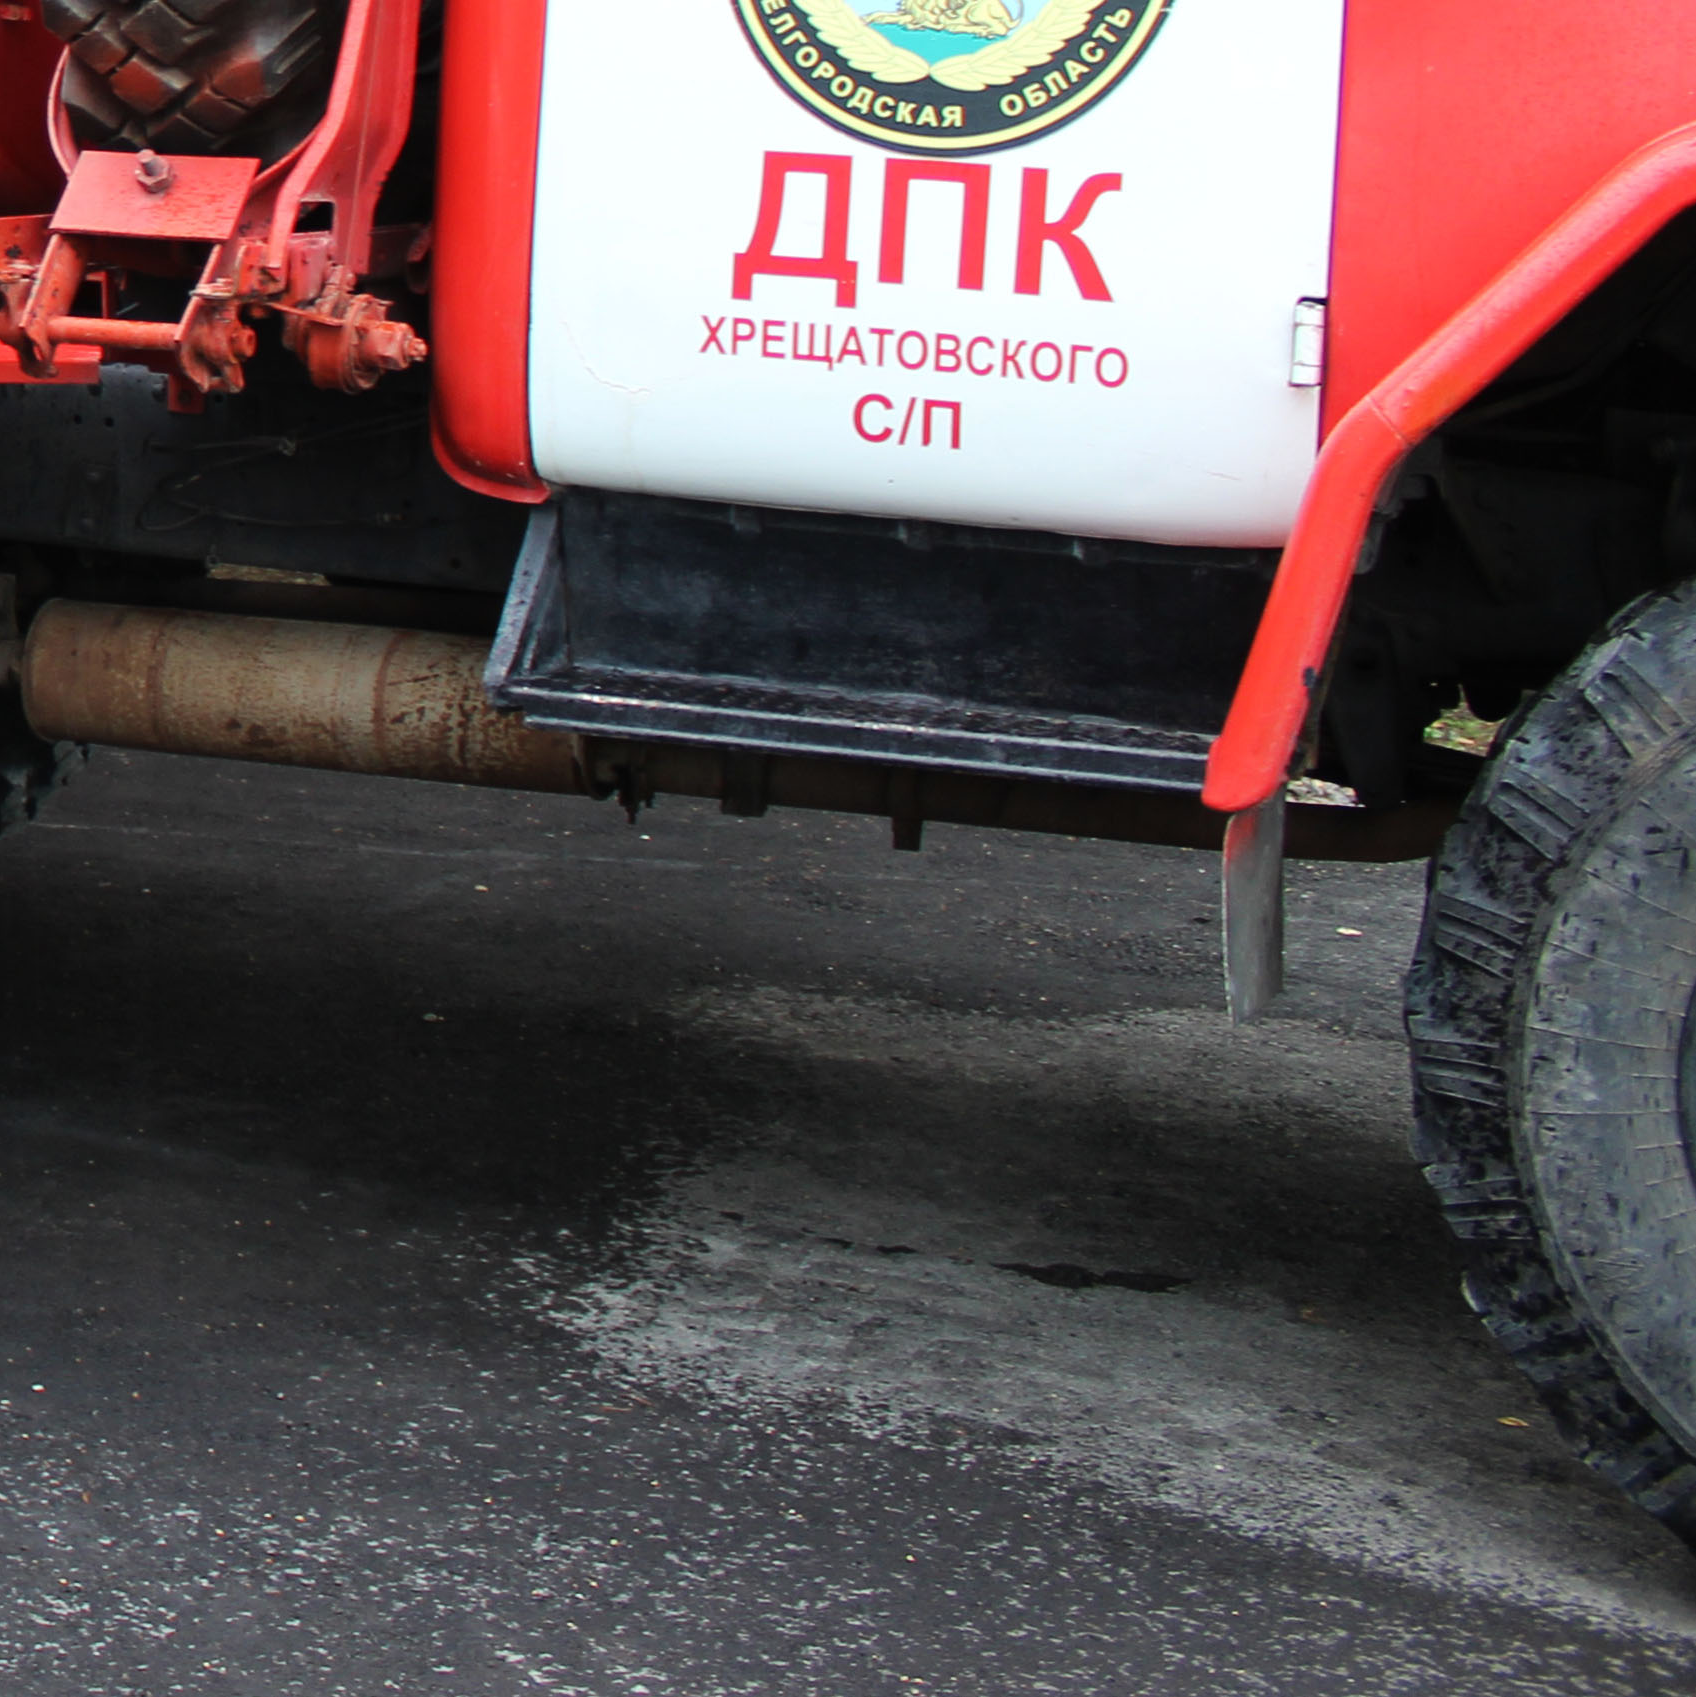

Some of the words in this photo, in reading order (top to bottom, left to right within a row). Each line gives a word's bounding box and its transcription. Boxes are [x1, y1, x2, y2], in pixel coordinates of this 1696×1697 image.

[999, 7, 1135, 117] ОБЛАСТЬ
[731, 150, 1123, 309] ДПК
[699, 315, 1129, 388] ХРЕЩАТОВСКОГО
[852, 393, 961, 450] С/П
